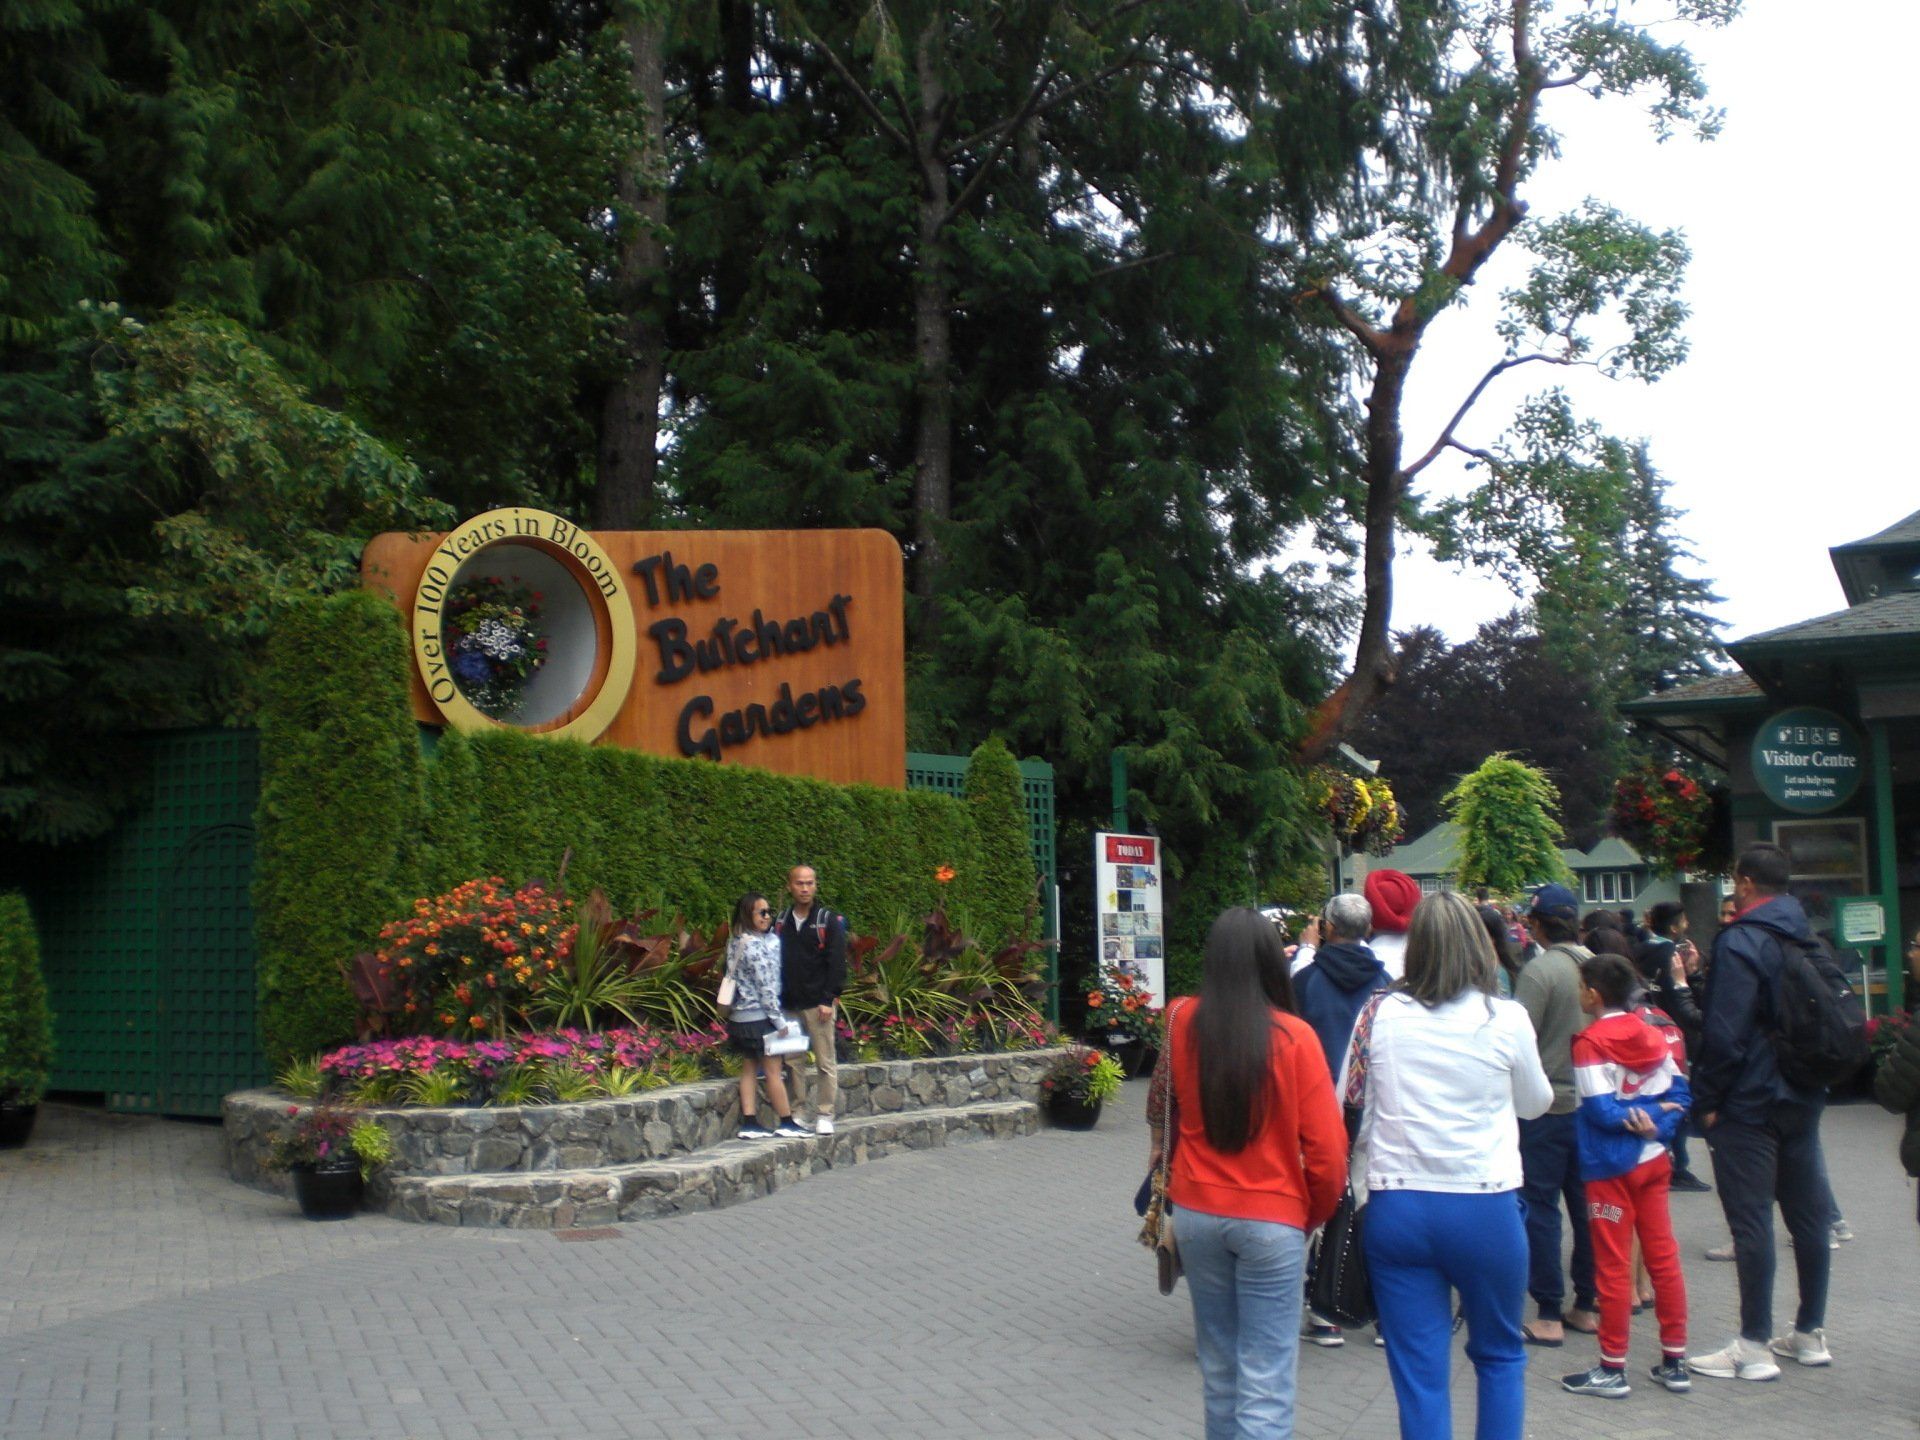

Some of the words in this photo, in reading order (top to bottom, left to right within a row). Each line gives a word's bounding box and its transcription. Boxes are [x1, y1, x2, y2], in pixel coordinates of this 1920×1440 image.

[439, 519, 506, 565] Years
[514, 509, 540, 536] in
[548, 517, 617, 598] Bloom
[632, 550, 720, 607] The
[417, 566, 449, 615] 100
[649, 593, 853, 685] Butchart
[423, 629, 455, 703] Over
[677, 679, 867, 763] Gardens
[1762, 750, 1810, 766] Visitor
[1812, 751, 1856, 767] Centre
[1806, 775, 1821, 786] help
[1822, 777, 1836, 786] you
[1784, 788, 1800, 798] plan
[1801, 790, 1817, 798] your
[1116, 844, 1144, 857] TODAY
